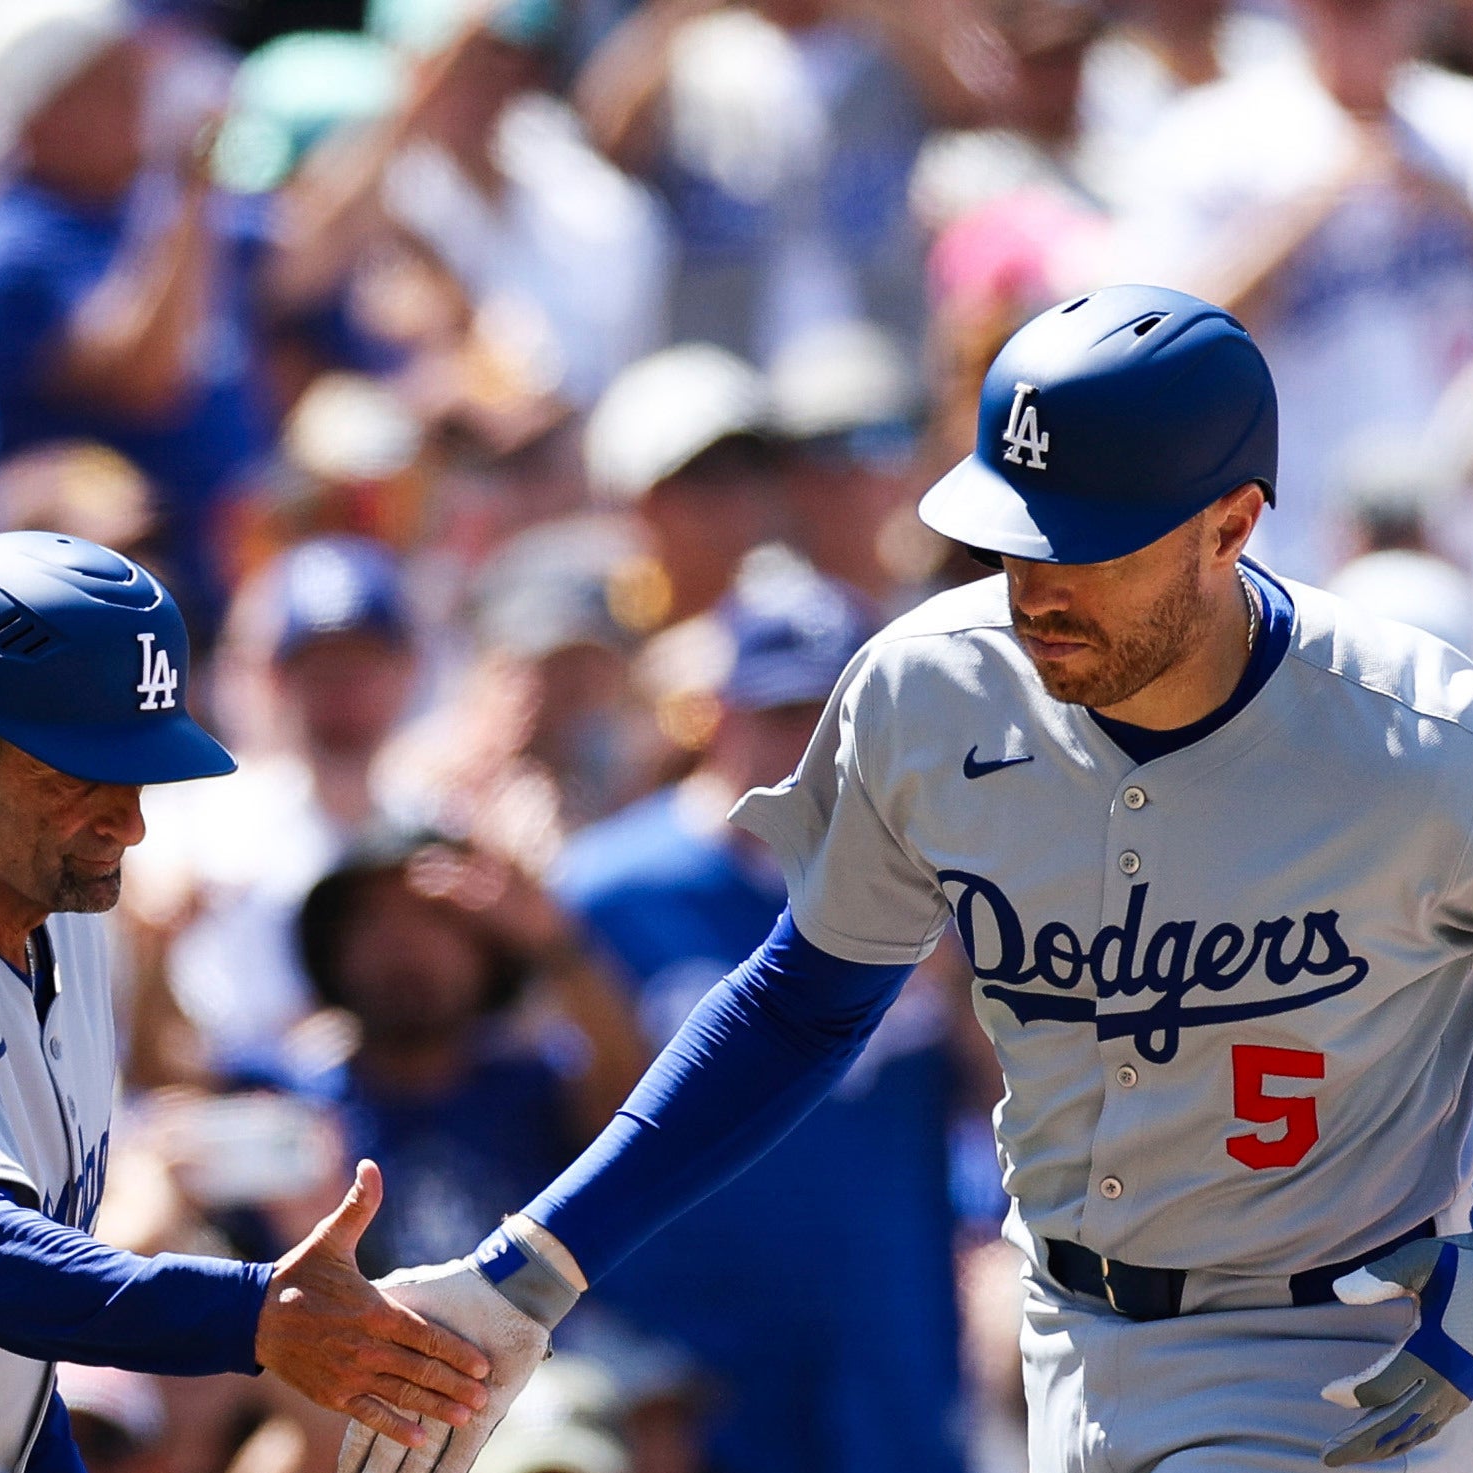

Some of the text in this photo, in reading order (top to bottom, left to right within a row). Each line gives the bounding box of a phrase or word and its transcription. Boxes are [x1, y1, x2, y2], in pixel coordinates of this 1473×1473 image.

[1003, 382, 1049, 470] LA
[137, 633, 177, 710] LA
[937, 869, 1369, 1064] Dodgers
[1226, 1044, 1325, 1170] 5
